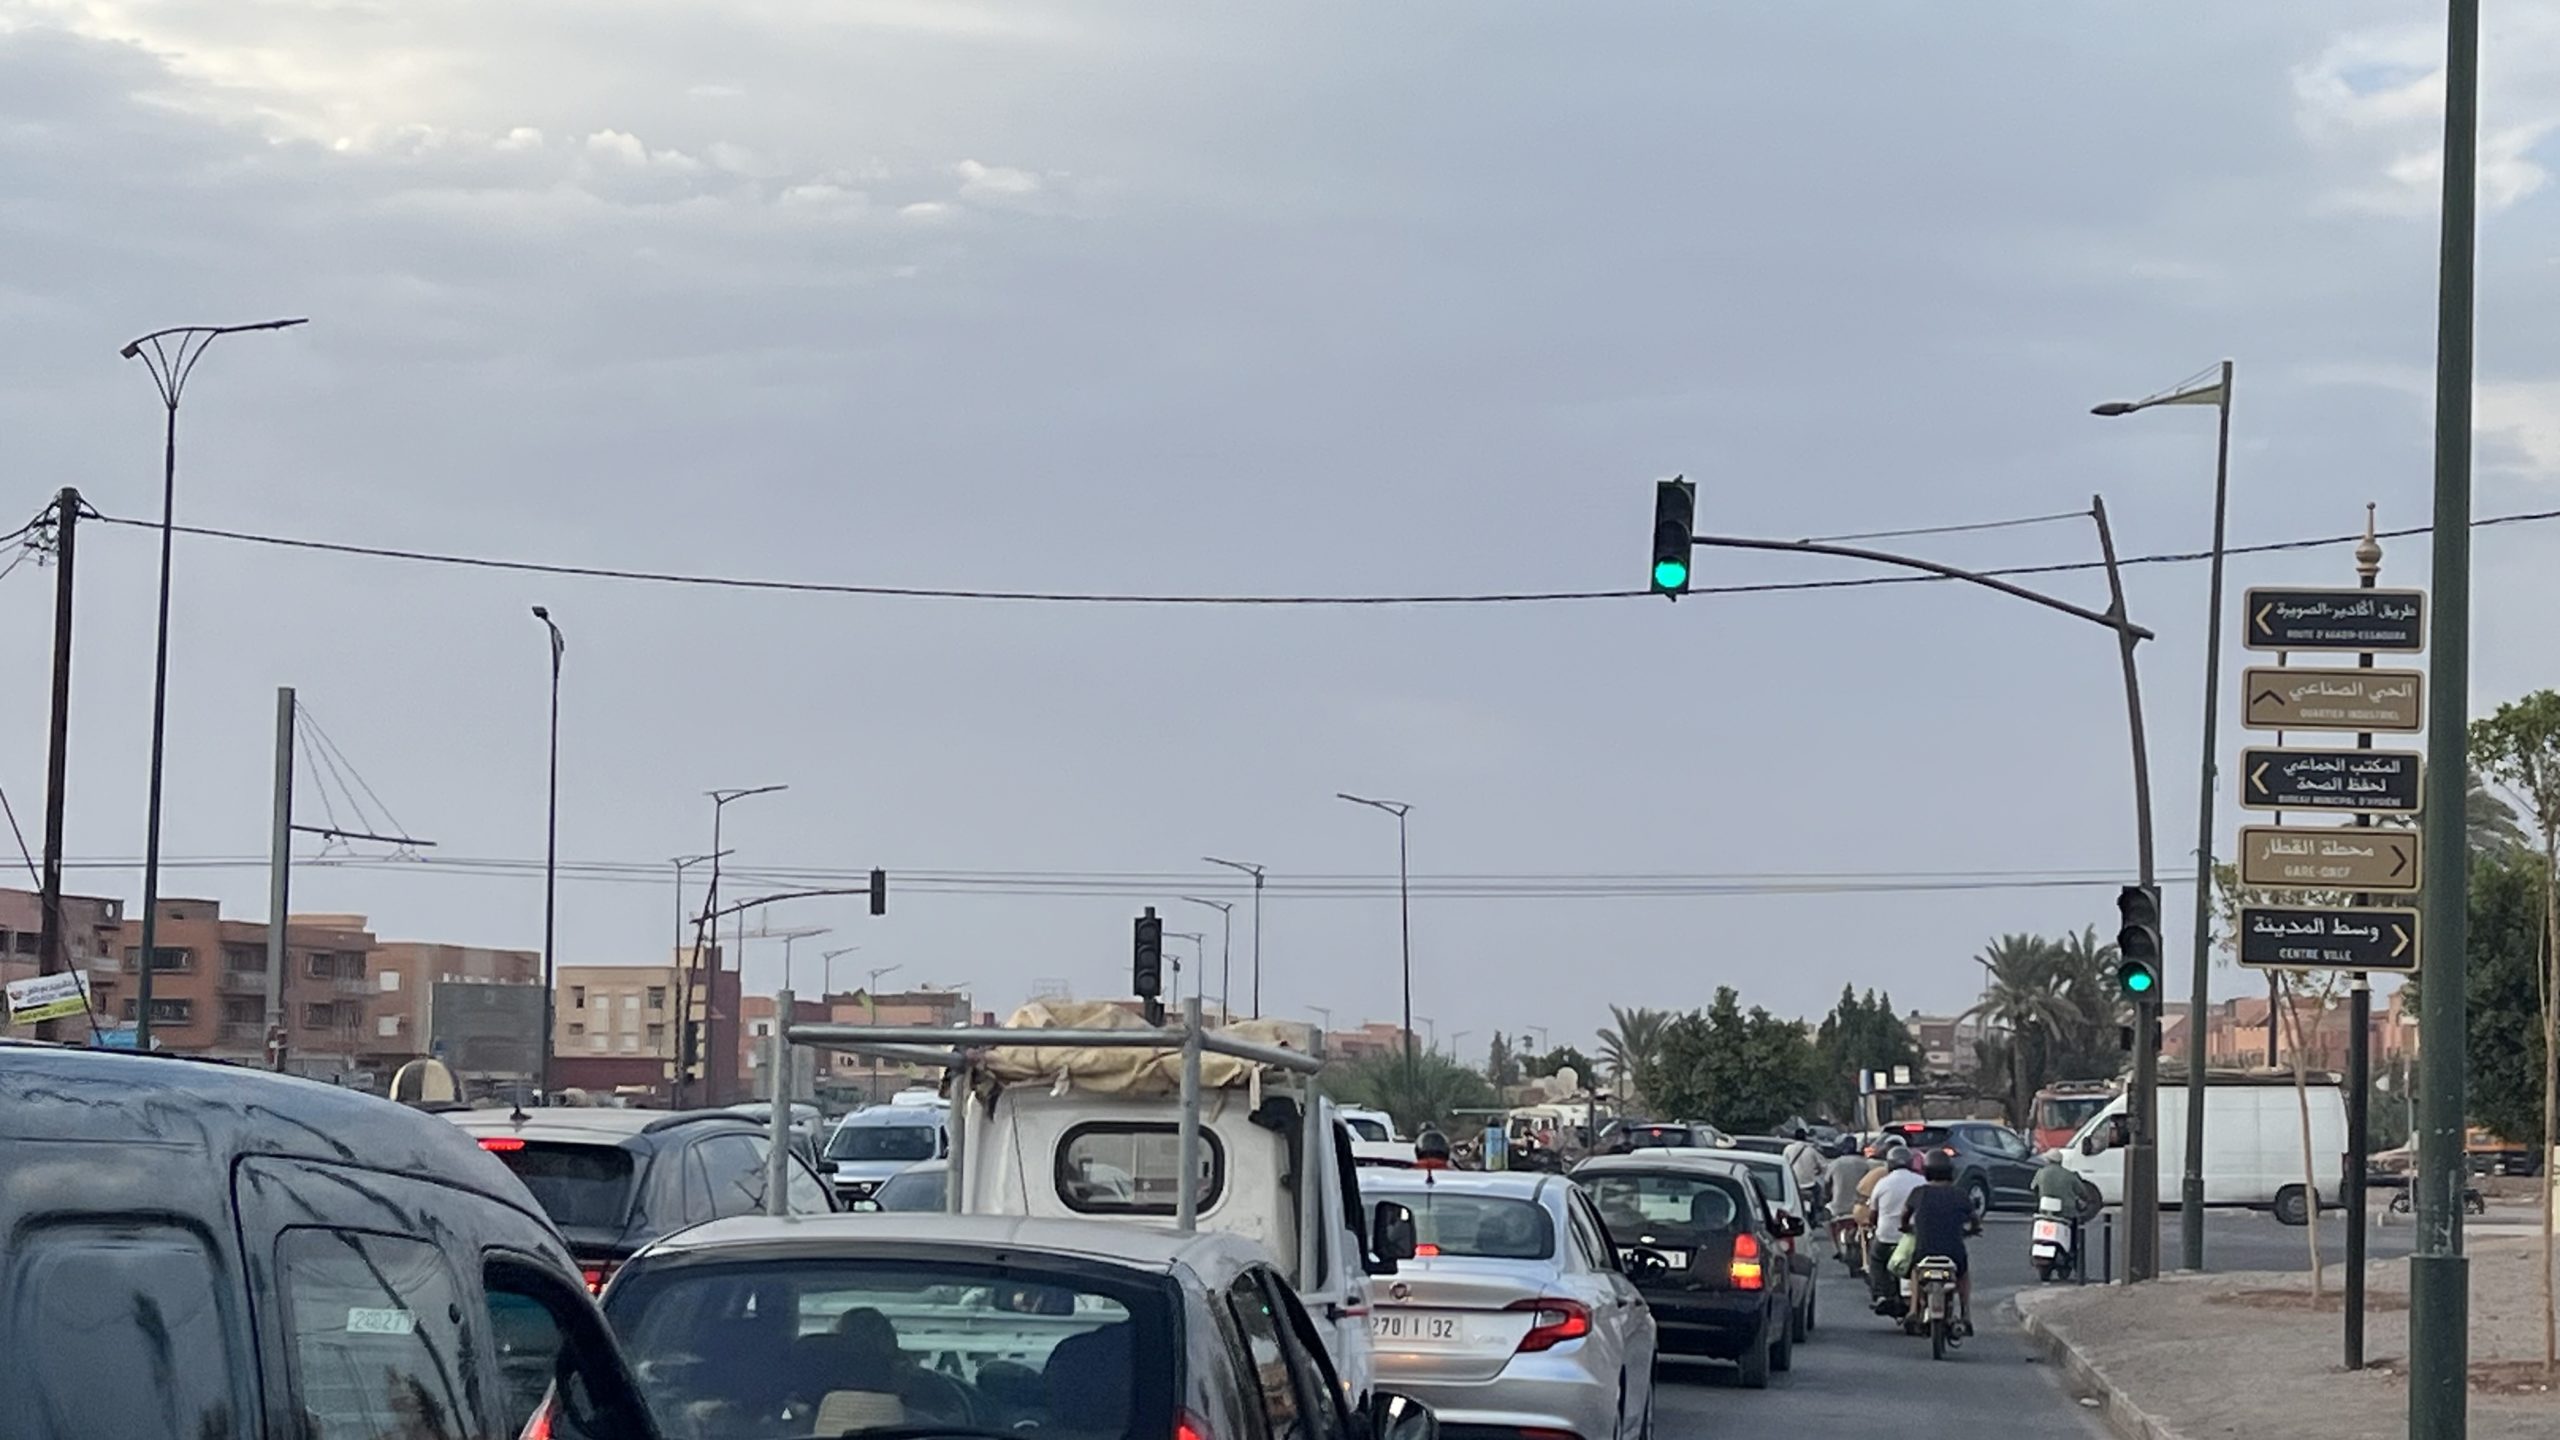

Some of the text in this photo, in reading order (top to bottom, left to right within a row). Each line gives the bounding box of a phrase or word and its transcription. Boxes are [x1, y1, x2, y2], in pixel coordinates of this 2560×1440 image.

[2378, 604, 2416, 620] طريق
[2288, 681, 2412, 703] الحي الصناعي
[2283, 757, 2400, 776] المكتب الجماعي
[2296, 777, 2386, 792] لحفظ الصحة
[2262, 838, 2374, 860] محطة القطار
[2253, 916, 2379, 942] وسط المدينة
[2279, 948, 2352, 961] CENTRE VILLE
[1432, 1319, 1453, 1338] 32
